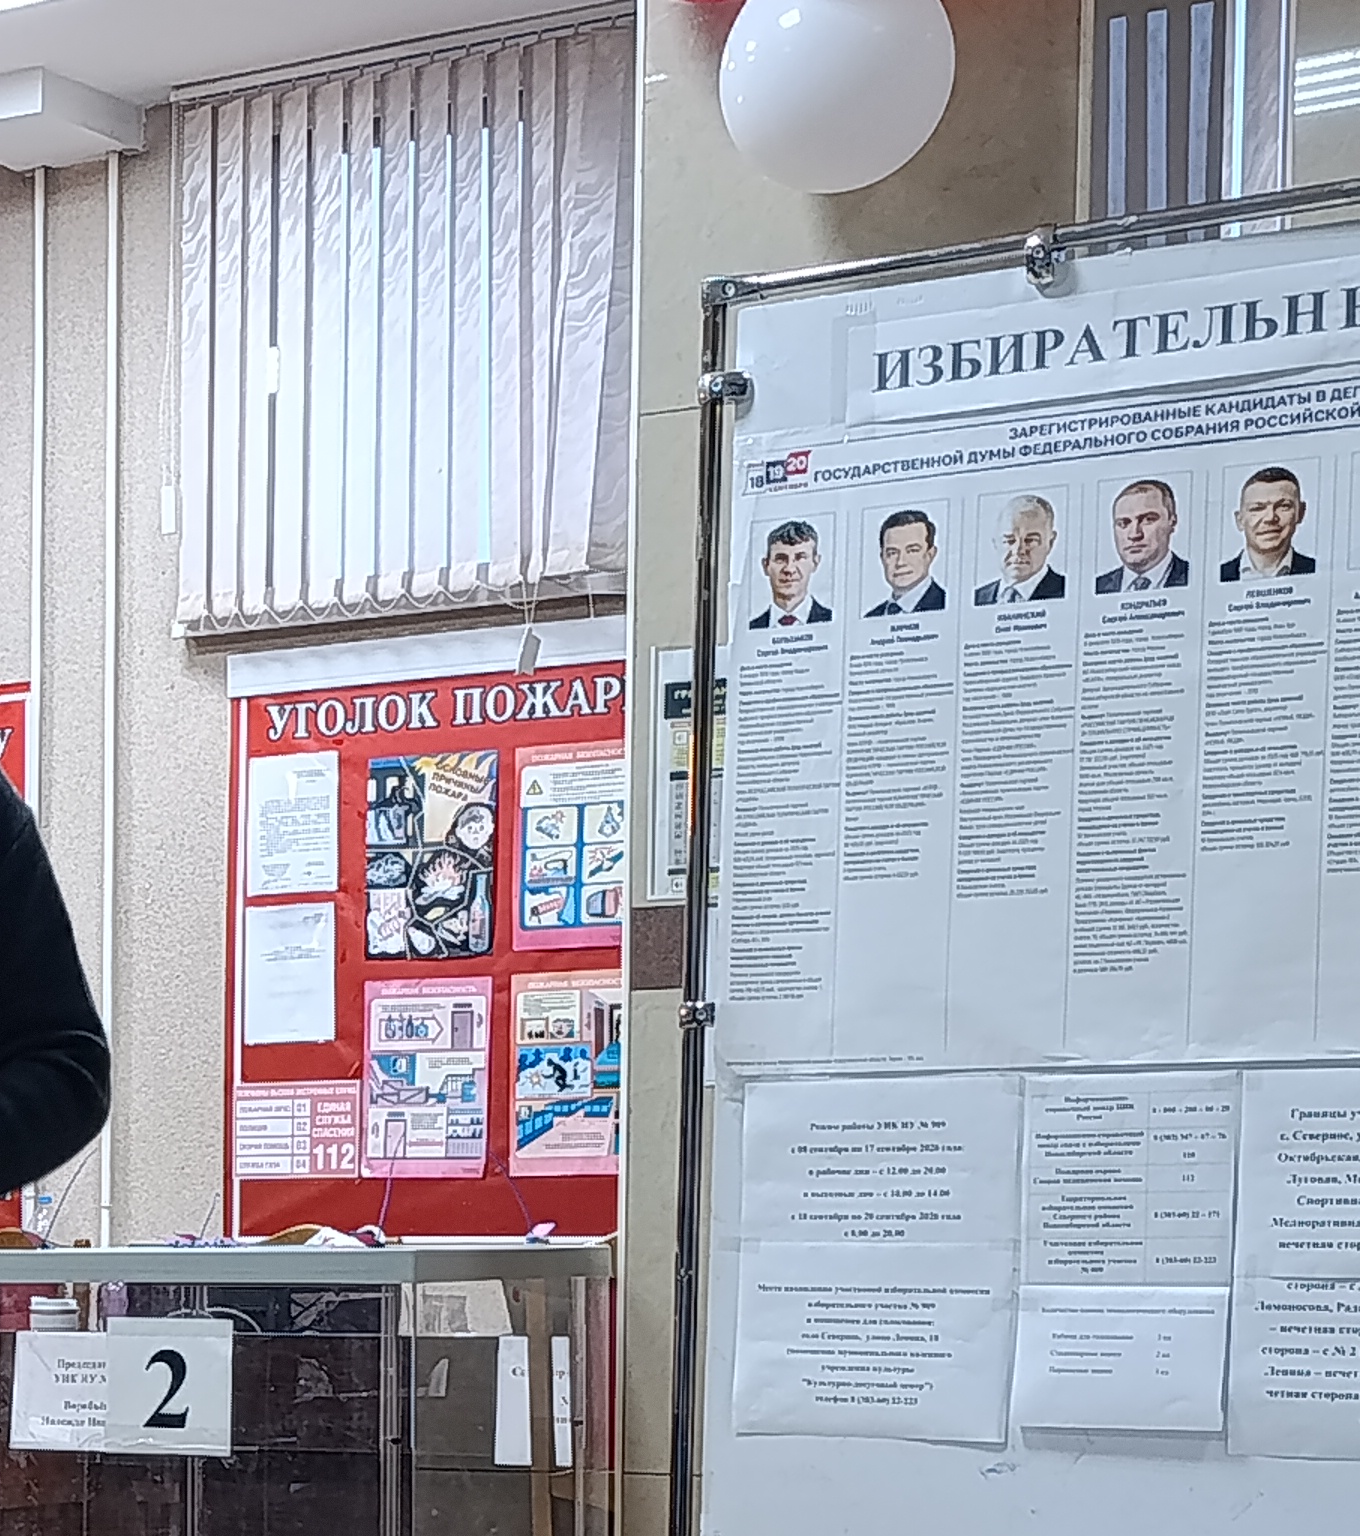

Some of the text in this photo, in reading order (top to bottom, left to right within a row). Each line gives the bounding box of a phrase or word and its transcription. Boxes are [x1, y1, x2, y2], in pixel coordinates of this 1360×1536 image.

[1009, 404, 1202, 440] ЗАРЕГИСТРИРОВАННЫЕ
[1205, 391, 1312, 416] КАНДИДАТЫ
[1316, 389, 1326, 402] В
[813, 401, 1360, 483] ГОСУДАРСТВЕННОЙ ДУМЫ ФЕДЕРАЛЬНОГО СОБРАНИЯ РОССИЙСКОЙ
[786, 455, 807, 472] 20
[767, 464, 785, 480] 19
[749, 475, 764, 489] 18
[265, 673, 626, 741] УГОЛОК ПОЖАР
[431, 772, 484, 795] ПРИЧИНЫ
[428, 782, 470, 803] ПОЖАРА
[1290, 1108, 1347, 1121] Границы
[313, 1143, 355, 1170] 112
[1286, 1174, 1342, 1187] Луговая,
[1296, 1195, 1360, 1208] Спортивн
[1287, 1282, 1335, 1292] сторона
[1255, 1300, 1333, 1313] Ломоносова,
[1261, 1346, 1310, 1357] сторона
[1263, 1366, 1311, 1377] Ленина
[143, 1349, 190, 1429] 2
[1265, 1390, 1309, 1398] четная
